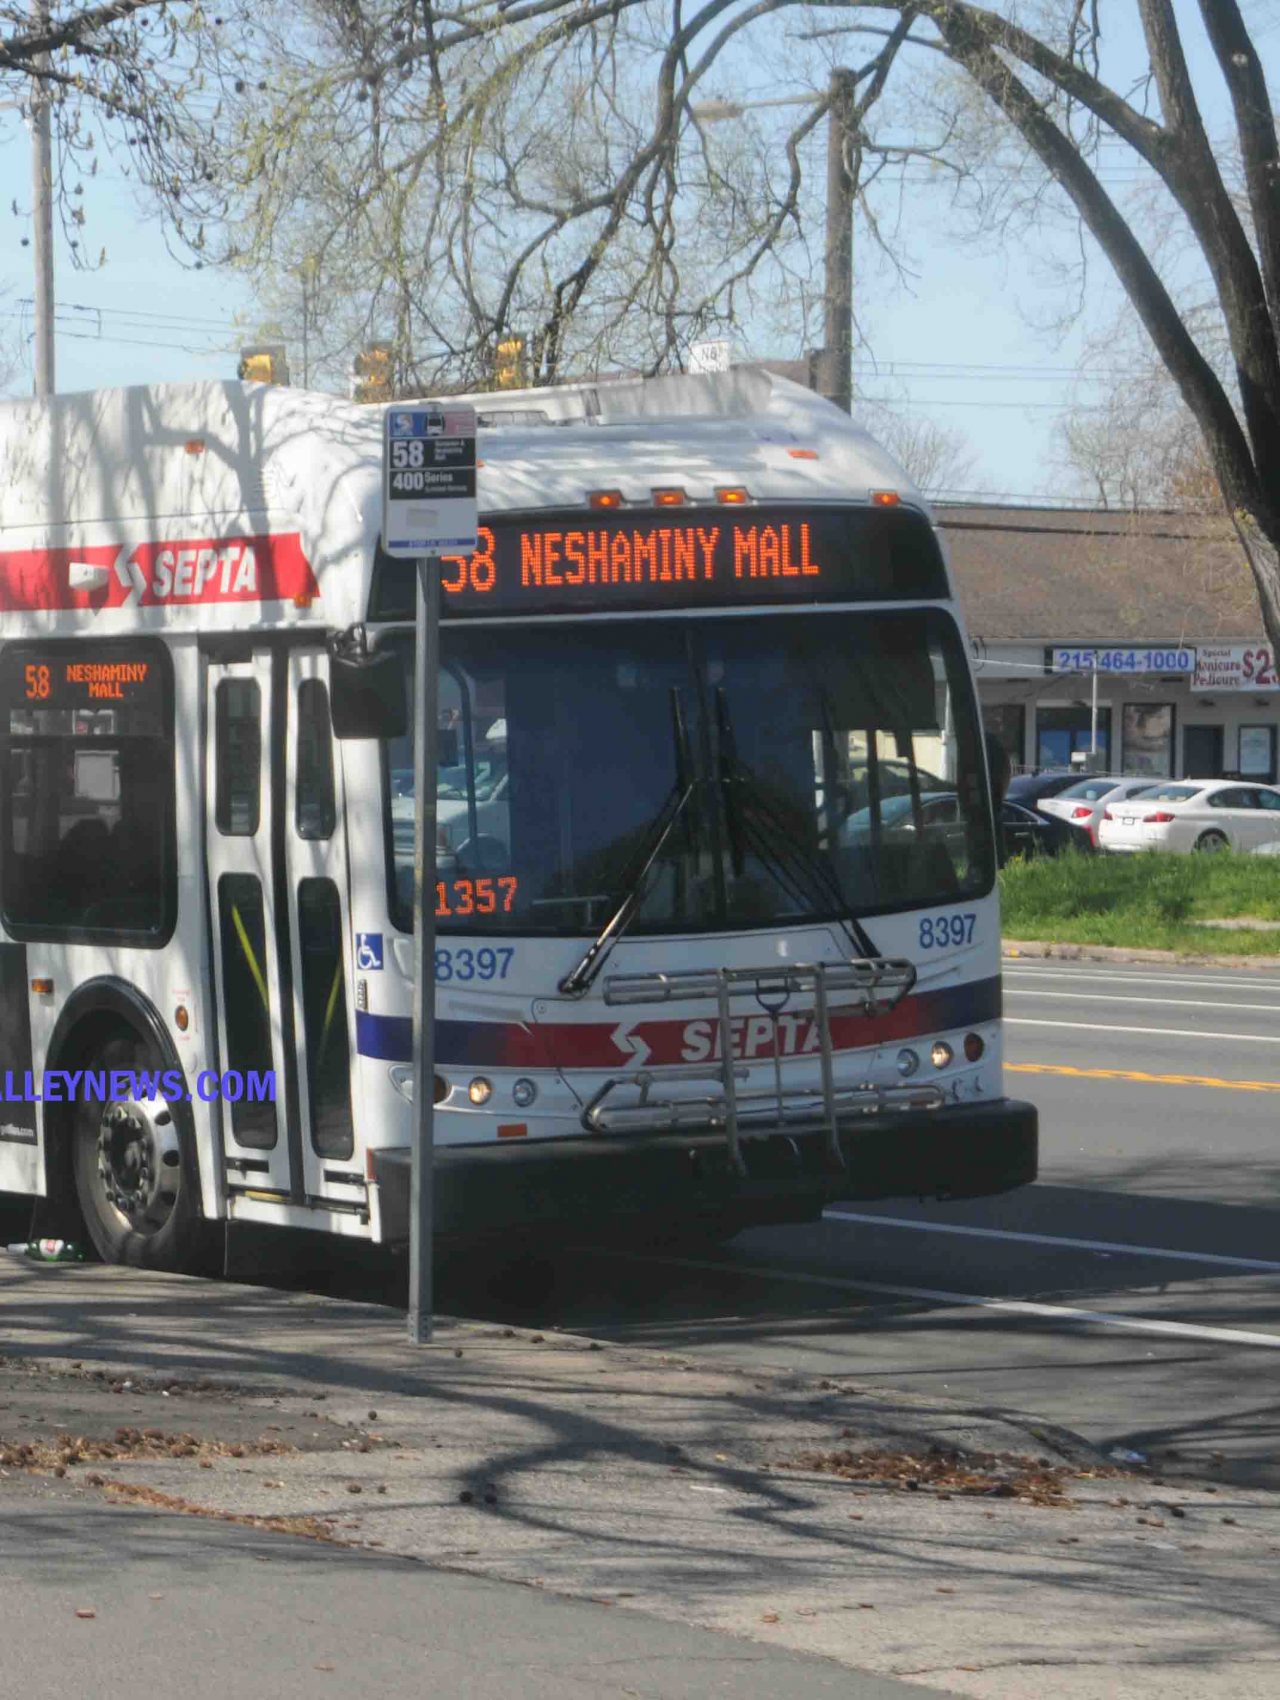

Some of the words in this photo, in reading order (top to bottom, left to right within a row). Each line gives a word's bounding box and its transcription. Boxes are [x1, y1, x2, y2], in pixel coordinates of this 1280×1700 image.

[392, 440, 424, 468] 58
[392, 472, 424, 491] 400
[152, 546, 257, 597] SEPTA
[440, 526, 496, 592] 58
[521, 526, 719, 587] NESHAMINY
[733, 523, 821, 579] MALL
[1059, 650, 1189, 670] 215464-1000
[24, 663, 51, 699] 58
[66, 662, 148, 683] NESHAMINY
[88, 682, 124, 698] MALL
[435, 876, 518, 916] 1357
[920, 913, 977, 949] 8397
[435, 947, 515, 981] 8397
[681, 1012, 834, 1062] SEPTA
